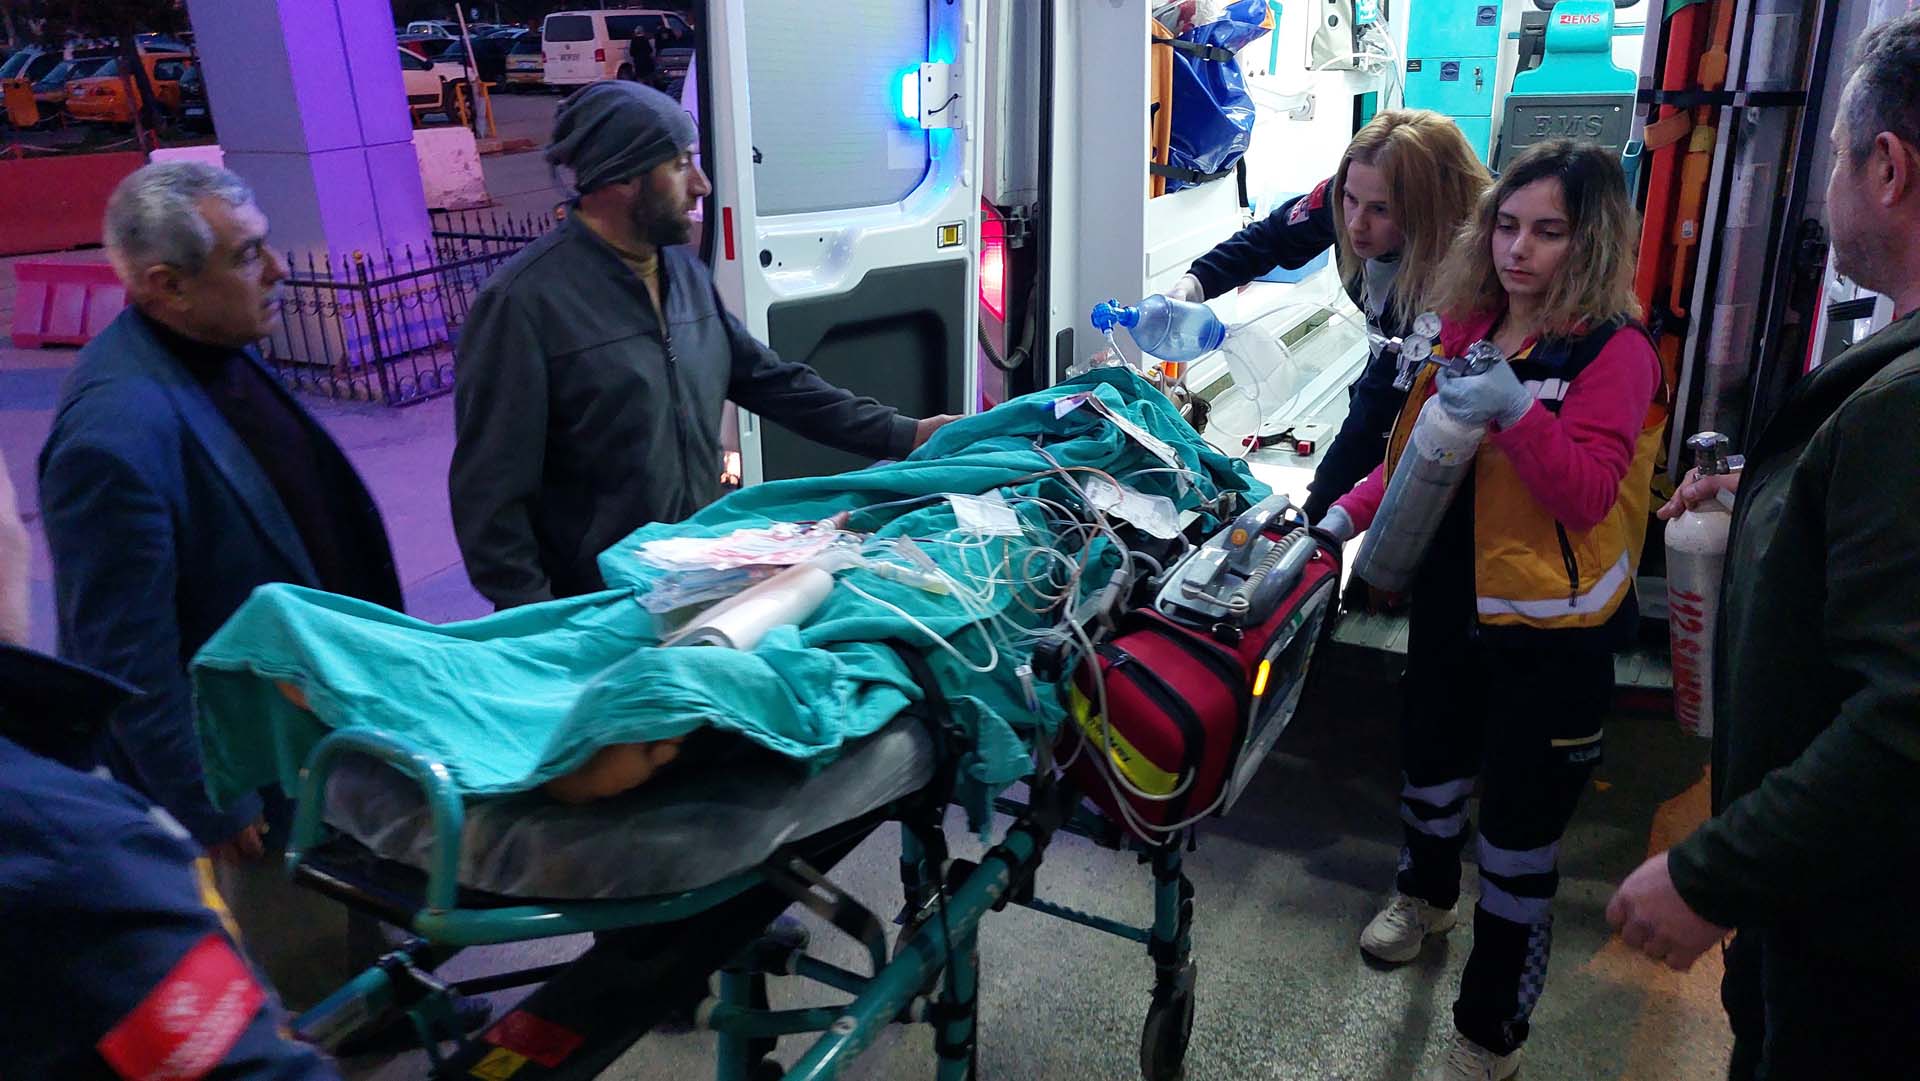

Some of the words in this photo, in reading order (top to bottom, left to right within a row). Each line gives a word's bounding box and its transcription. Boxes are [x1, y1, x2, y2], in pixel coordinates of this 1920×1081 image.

[1572, 14, 1600, 24] EMS
[1529, 113, 1604, 137] EMS
[1669, 586, 1704, 633] 112
